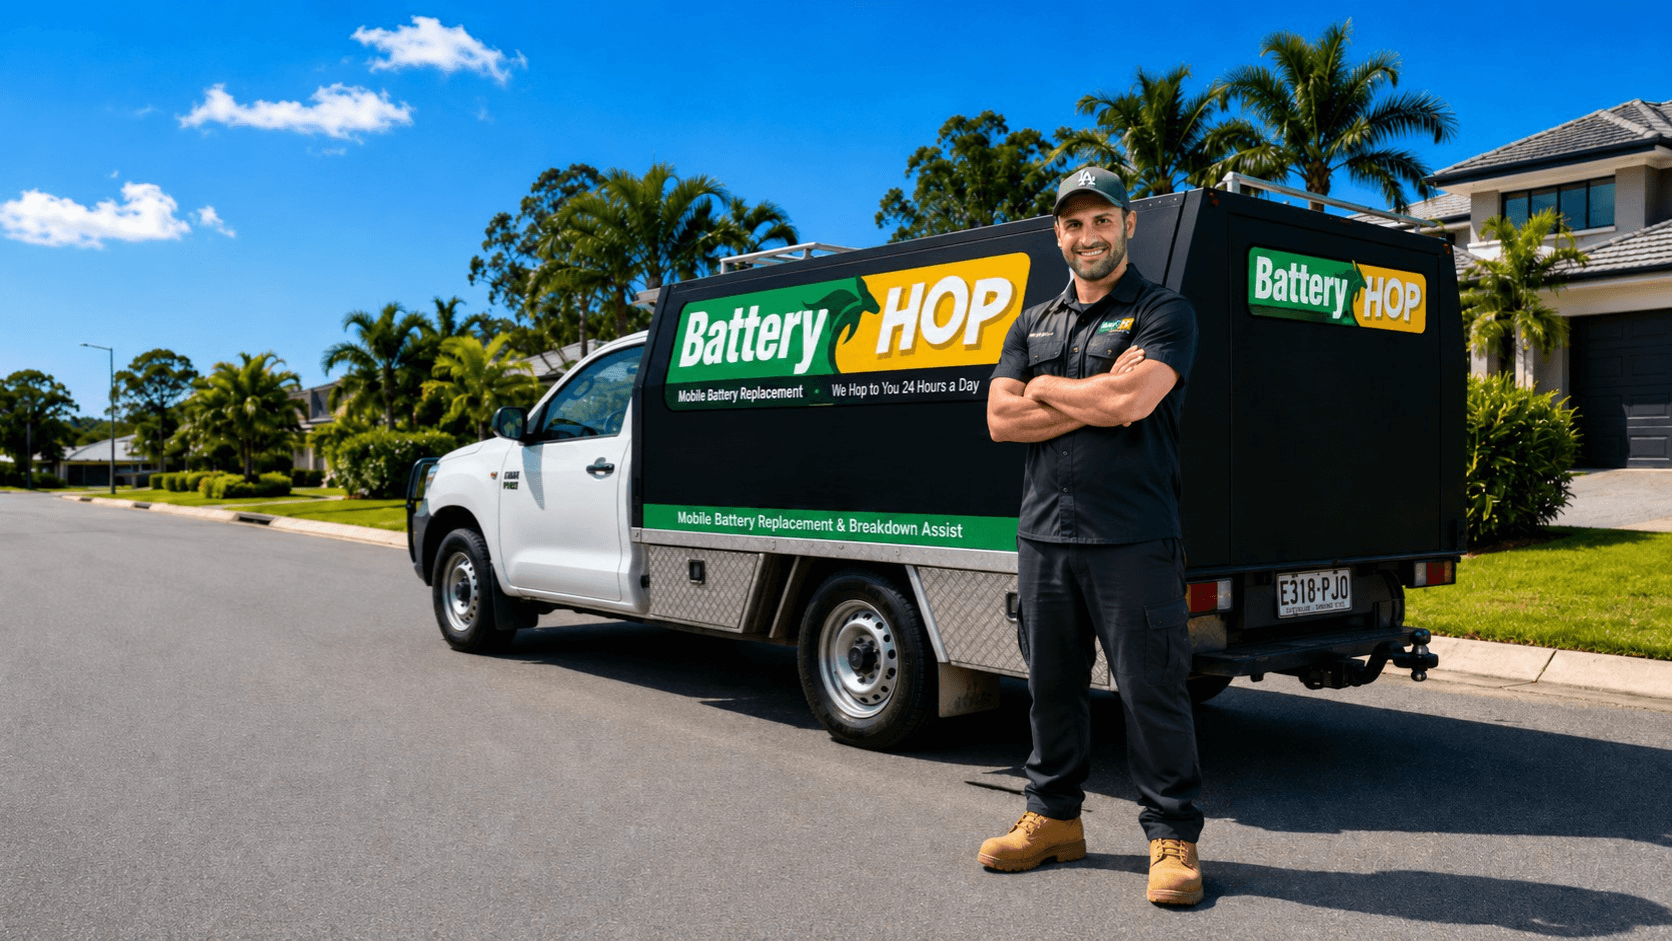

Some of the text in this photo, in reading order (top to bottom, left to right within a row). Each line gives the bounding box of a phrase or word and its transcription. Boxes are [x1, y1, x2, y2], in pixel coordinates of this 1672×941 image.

[1255, 256, 1421, 321] Battery HOP
[678, 275, 1013, 375] Battery HOP
[678, 384, 803, 403] Mobile Battery Replacement
[832, 377, 980, 399] We Hop to You 24 Hours a Day
[677, 511, 963, 538] Mobile Battery Replacement & Breakdown Assist
